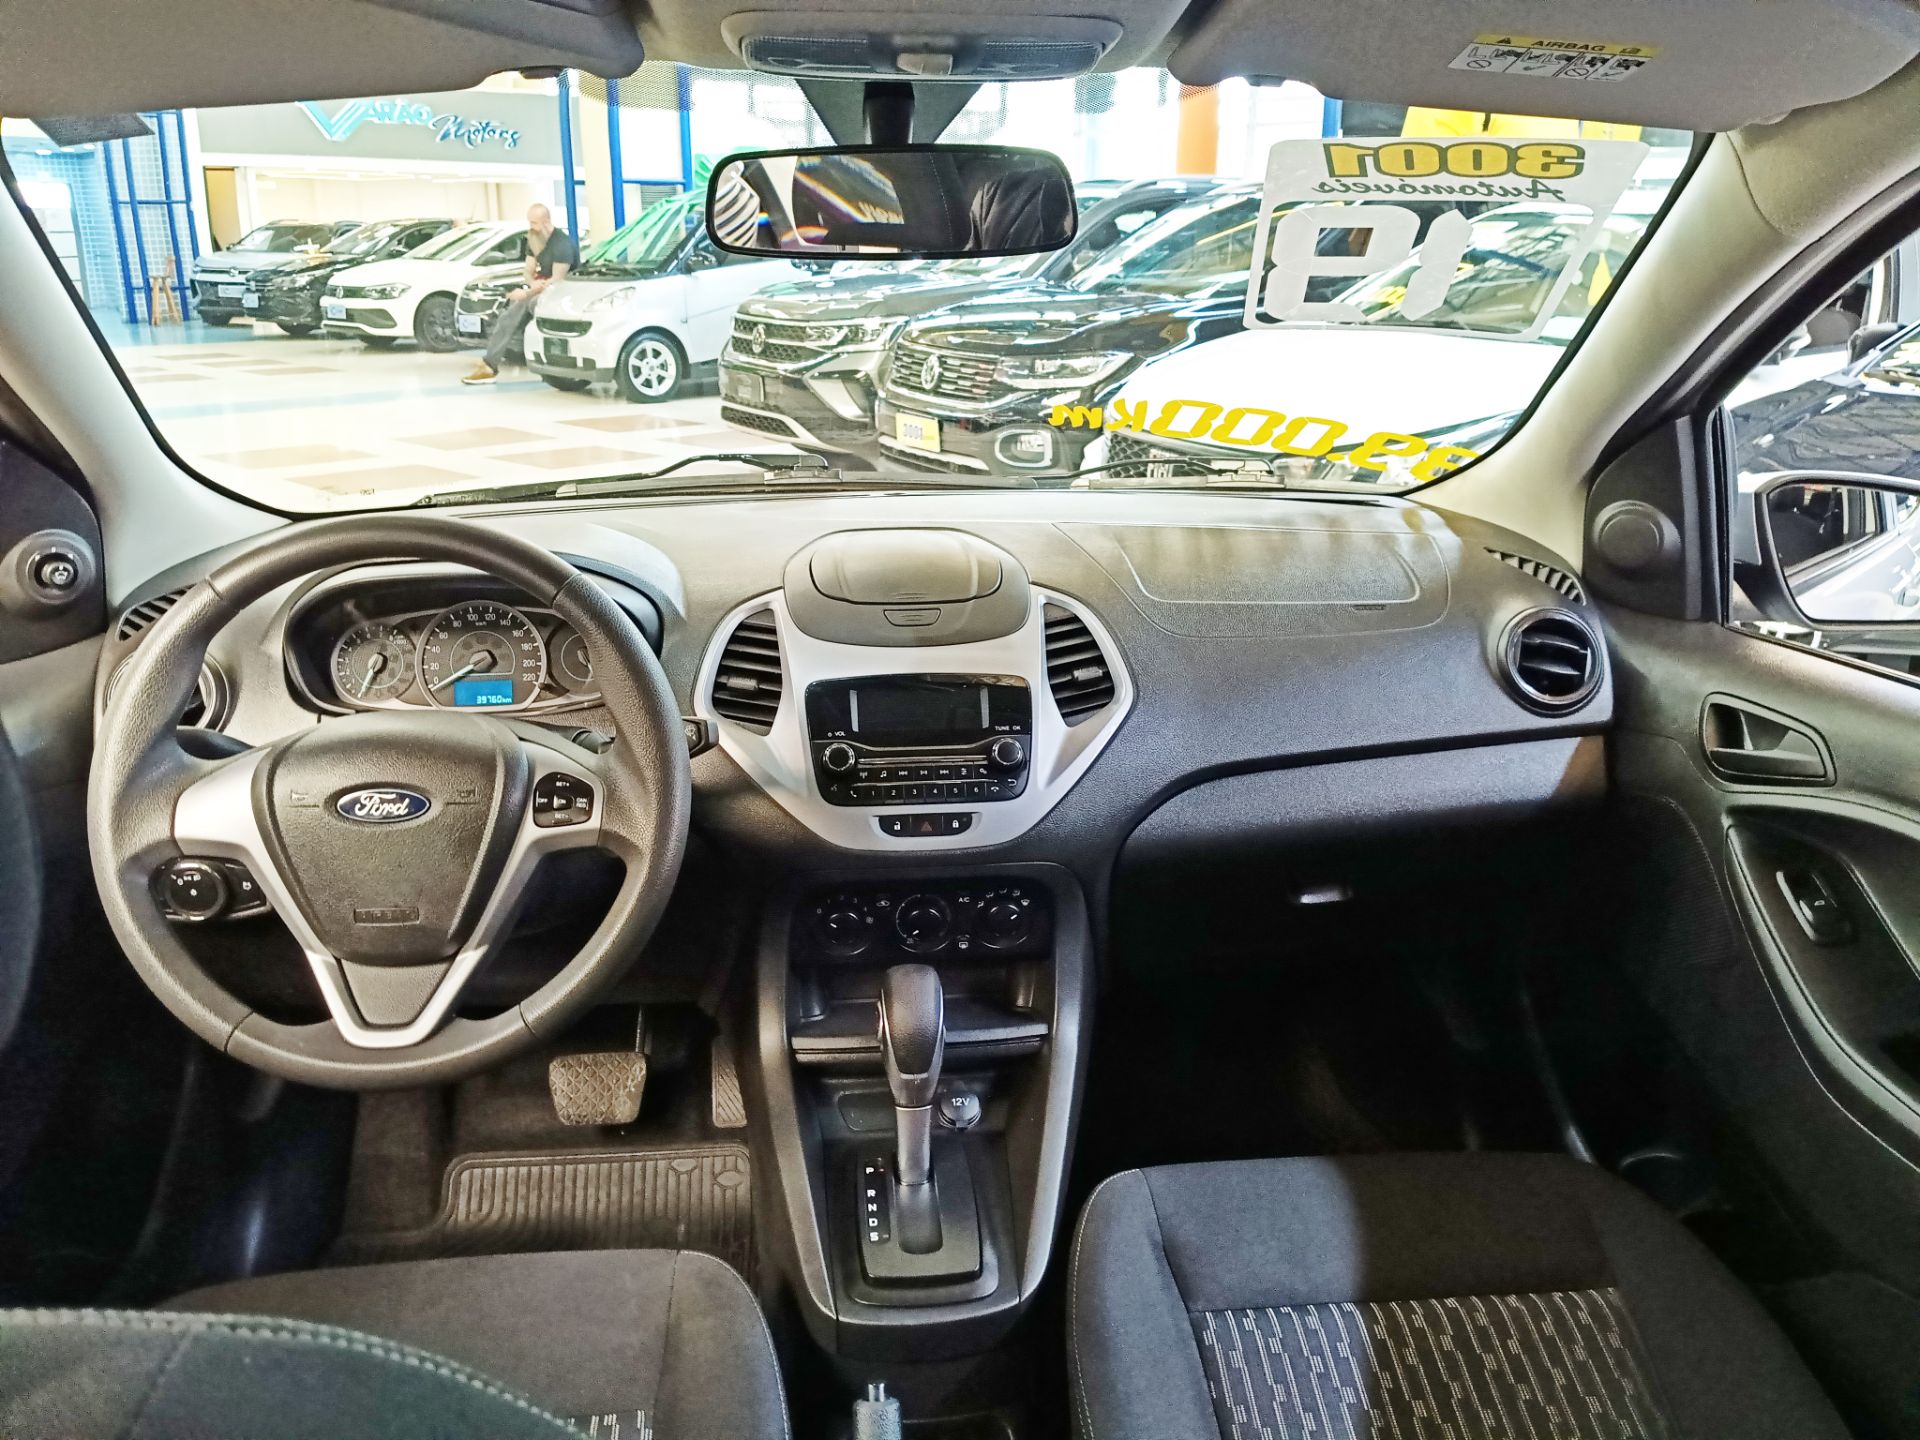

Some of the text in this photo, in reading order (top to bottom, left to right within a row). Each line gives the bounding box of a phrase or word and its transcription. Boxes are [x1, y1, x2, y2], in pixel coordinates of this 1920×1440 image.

[1531, 40, 1606, 52] AIRBAG
[355, 793, 410, 816] Ford
[951, 1097, 970, 1106] 12V
[867, 1189, 876, 1197] R
[868, 1203, 877, 1212] N
[869, 1218, 878, 1227] D
[869, 1232, 879, 1241] S
